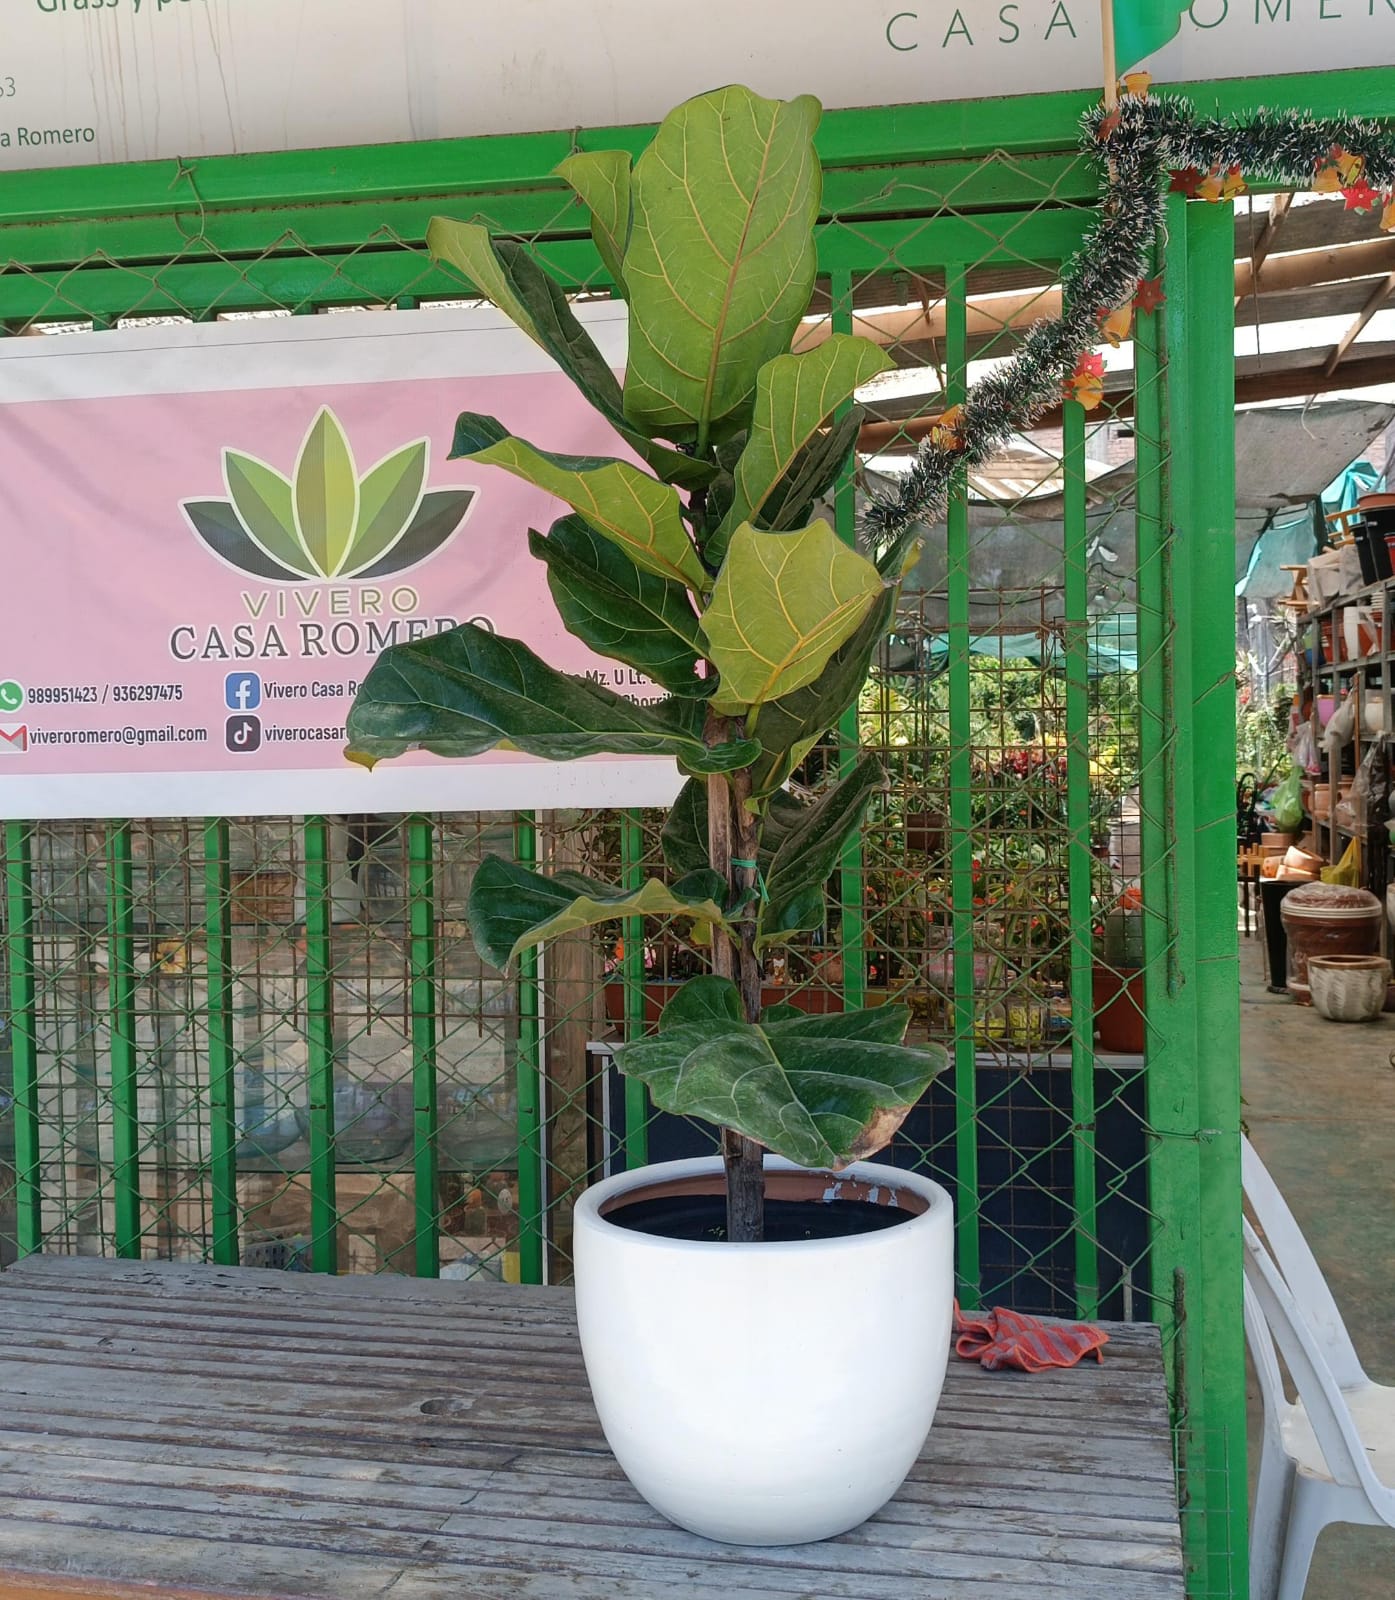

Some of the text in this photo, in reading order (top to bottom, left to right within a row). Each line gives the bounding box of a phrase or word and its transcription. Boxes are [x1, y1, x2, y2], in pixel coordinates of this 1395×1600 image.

[886, 1, 1077, 51] CASA
[17, 127, 95, 147] Romero
[242, 587, 419, 617] VIVERO
[170, 625, 288, 660] CASA
[614, 669, 624, 685] U
[28, 687, 98, 704] 989951423
[113, 685, 183, 701] 936297475
[264, 682, 308, 698] Vivero
[312, 681, 344, 697] Casa
[30, 726, 207, 745] viveroromero@gmail.com
[265, 725, 347, 741] viverocasar
